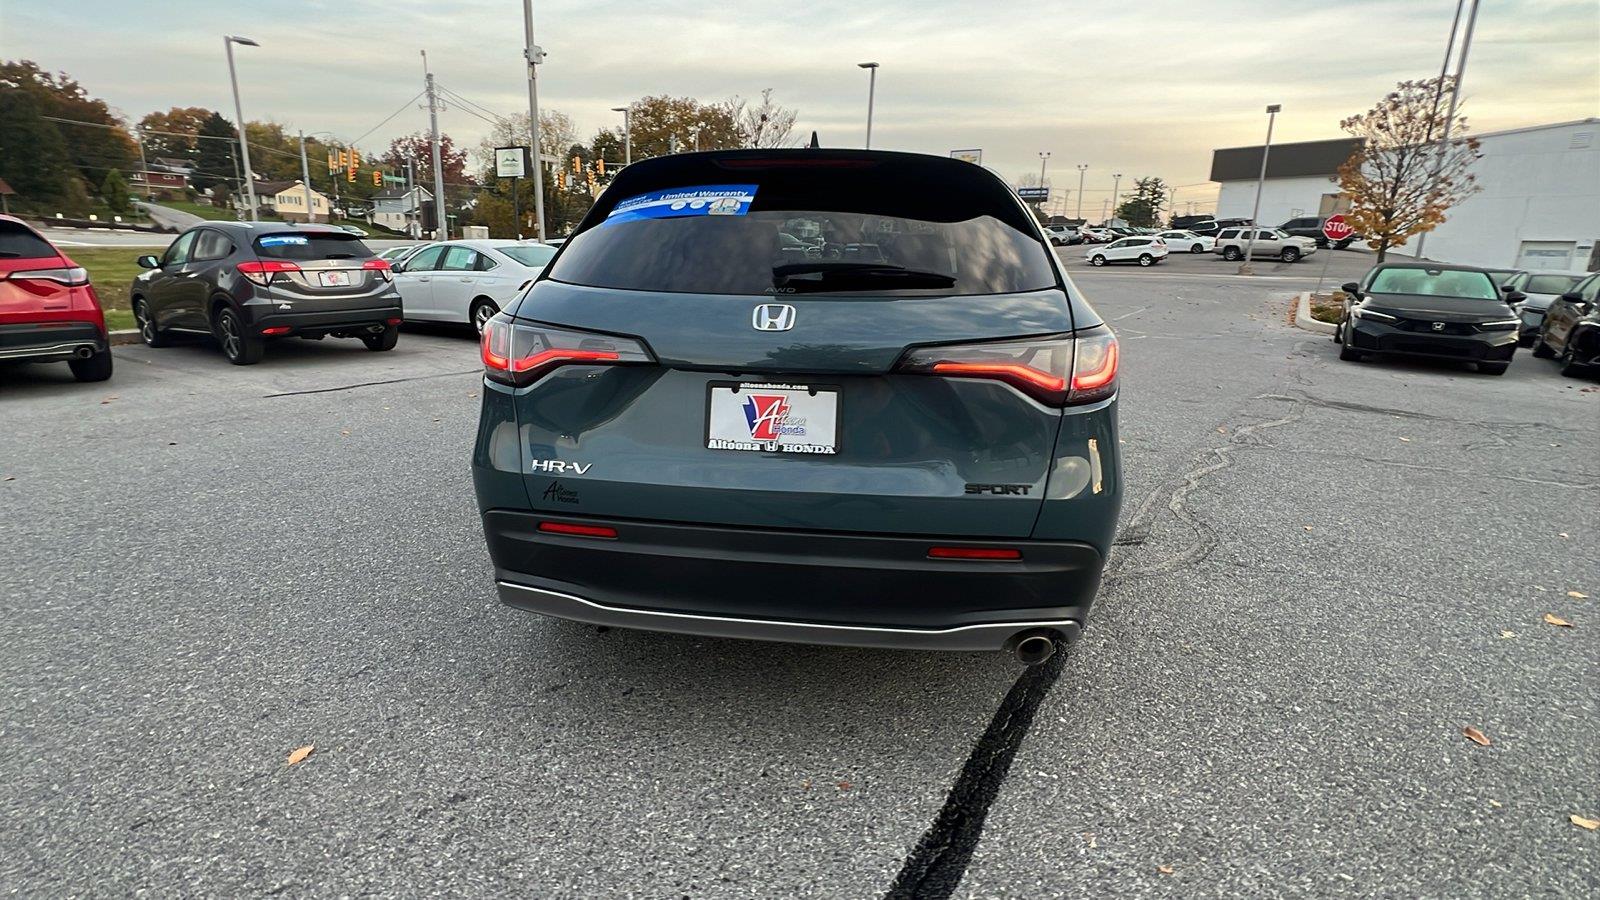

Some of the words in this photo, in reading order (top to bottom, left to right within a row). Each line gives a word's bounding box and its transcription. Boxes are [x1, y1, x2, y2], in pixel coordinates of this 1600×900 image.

[659, 191, 697, 201] Limited
[699, 189, 748, 198] Warranty
[739, 382, 809, 391] altoonahonda.com
[772, 424, 806, 436] Honda
[707, 439, 761, 451] Altoona
[782, 443, 836, 455] HONDA
[531, 459, 593, 475] HR-V
[964, 483, 1033, 496] SPORT
